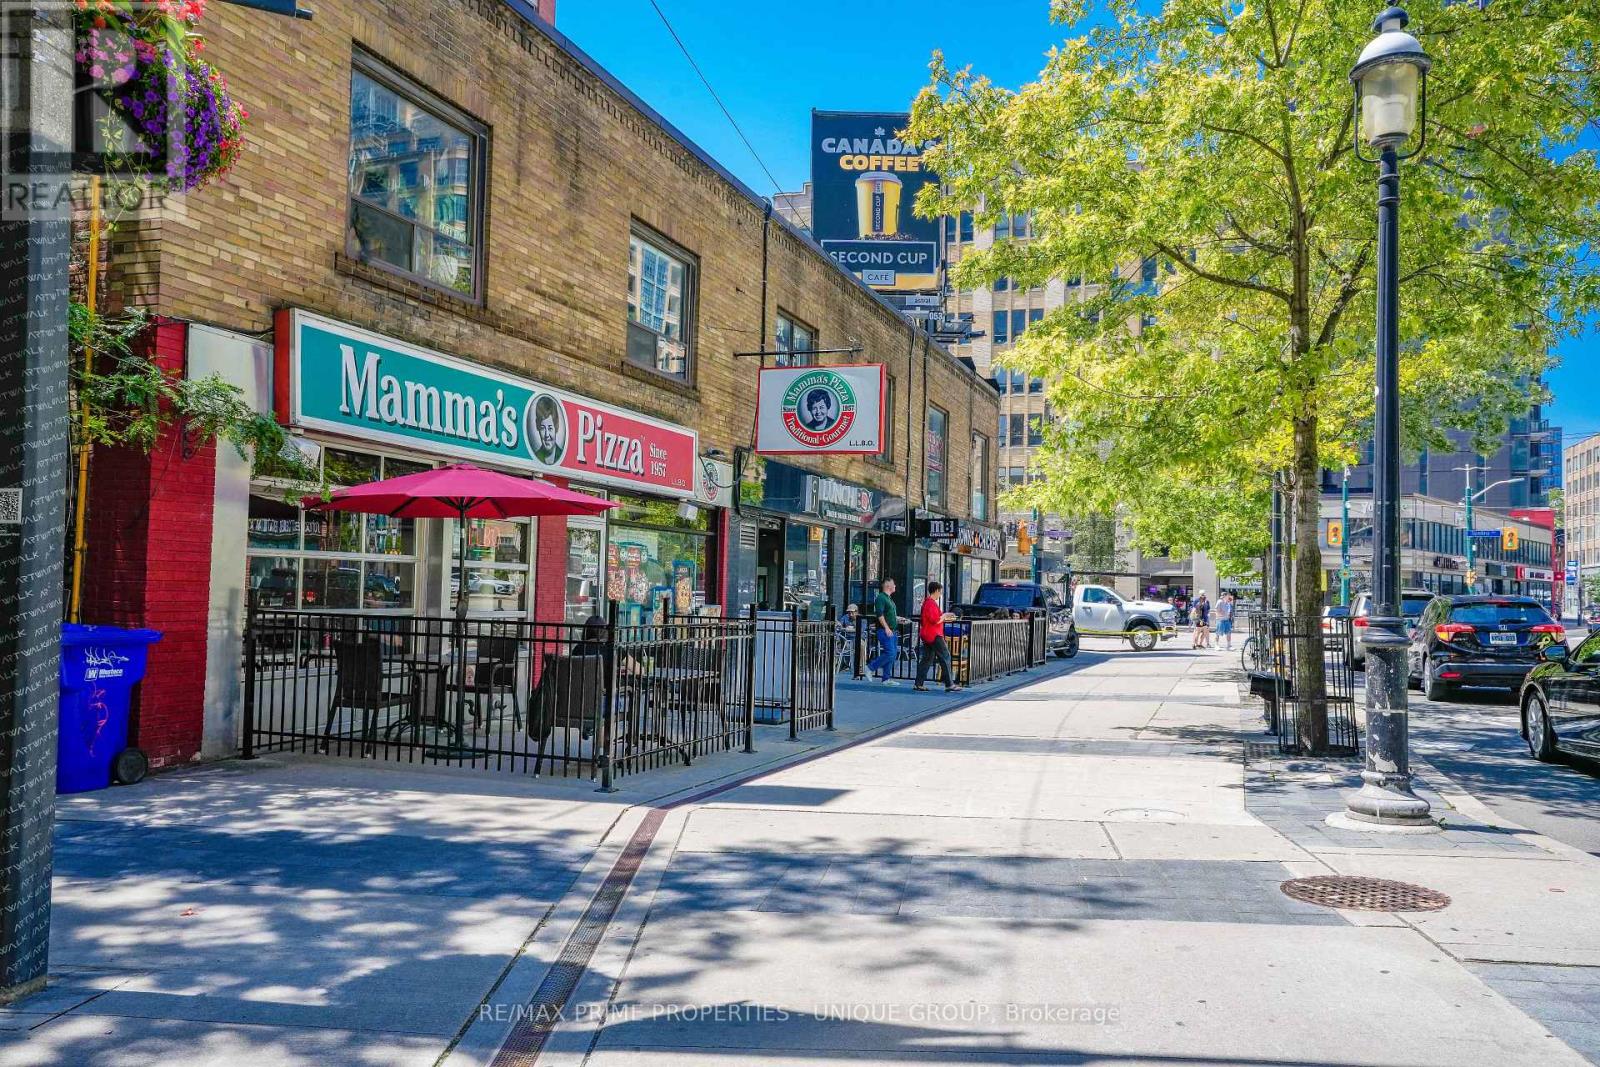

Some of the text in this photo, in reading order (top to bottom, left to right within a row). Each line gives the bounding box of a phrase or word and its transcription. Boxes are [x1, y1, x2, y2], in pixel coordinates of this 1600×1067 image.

[839, 154, 920, 171] COFFEE
[829, 251, 927, 264] SECOND CUP
[786, 375, 849, 403] Mamma's Pizza
[339, 344, 644, 475] Mamma's Pizza
[786, 415, 851, 445] Traditional Gourmet
[649, 442, 668, 460] Since
[650, 460, 667, 478] 1957
